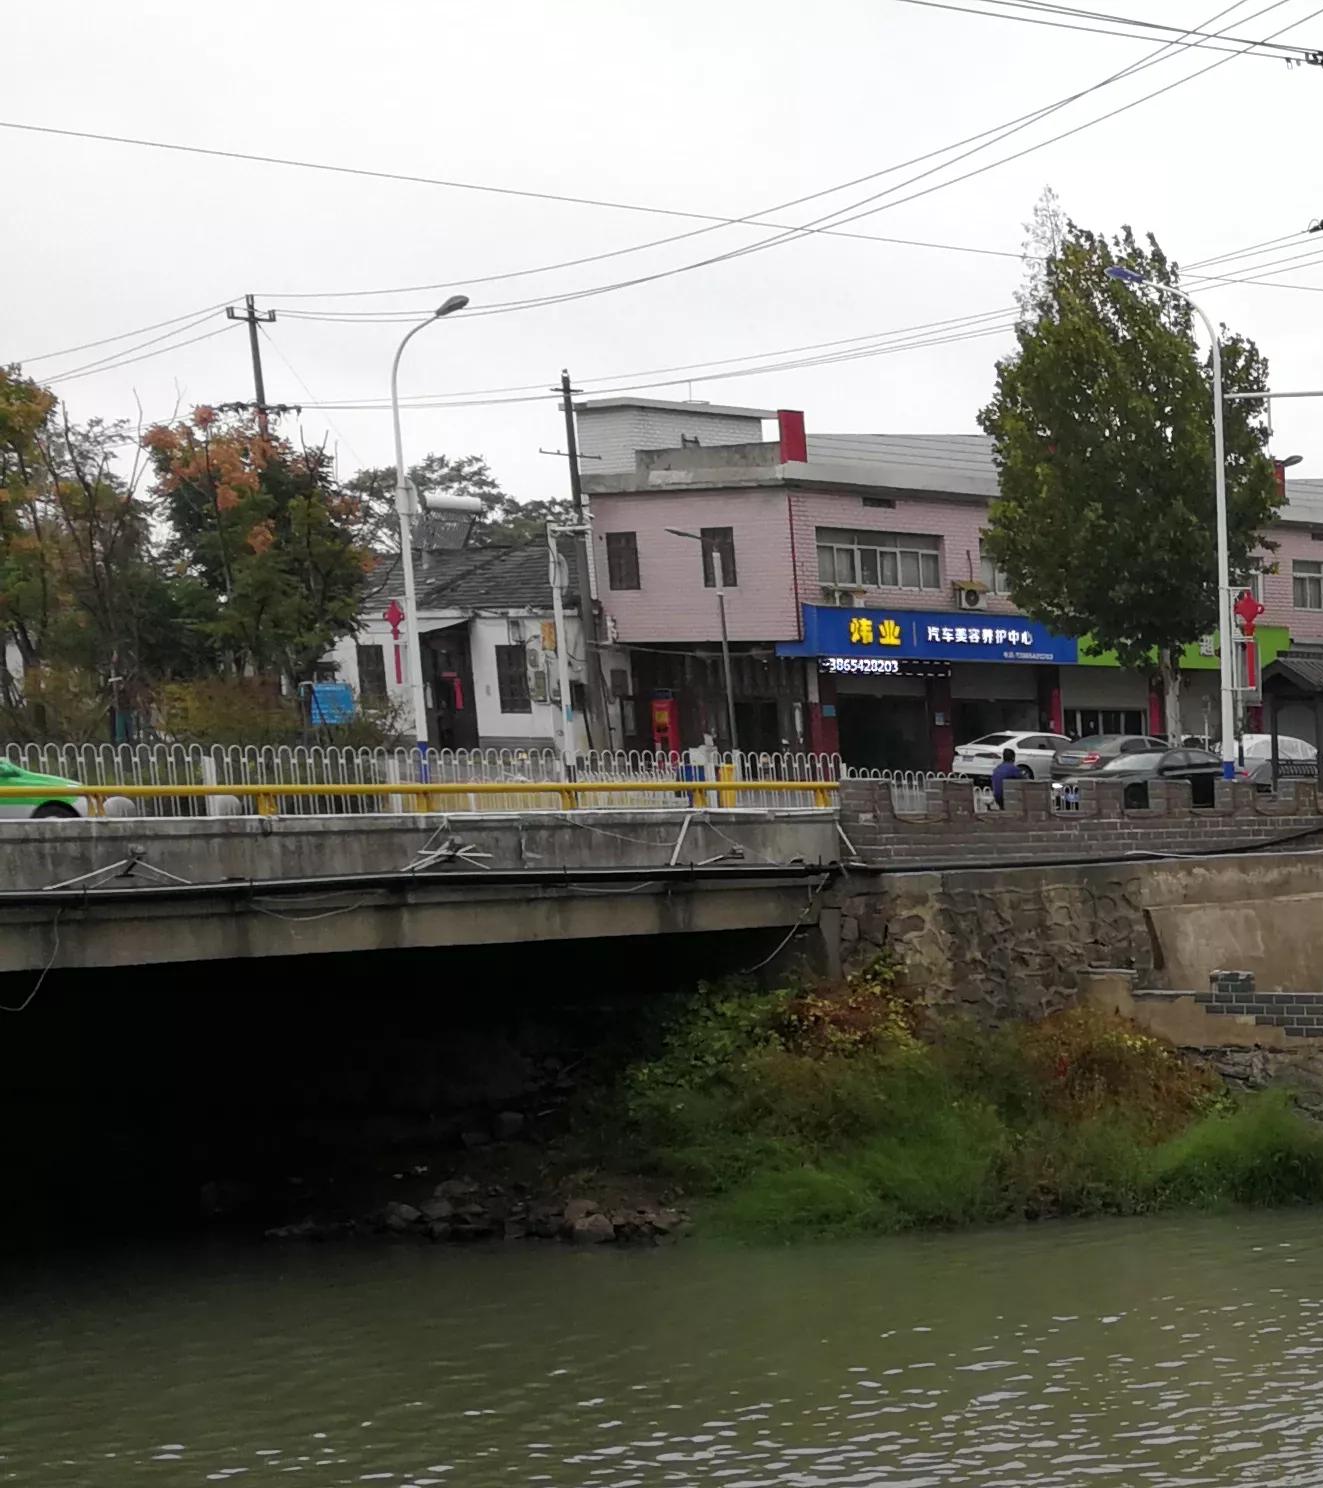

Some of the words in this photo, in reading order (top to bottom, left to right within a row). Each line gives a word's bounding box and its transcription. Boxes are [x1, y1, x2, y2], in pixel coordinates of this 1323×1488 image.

[927, 625, 1034, 646] 汽车美容养护中心
